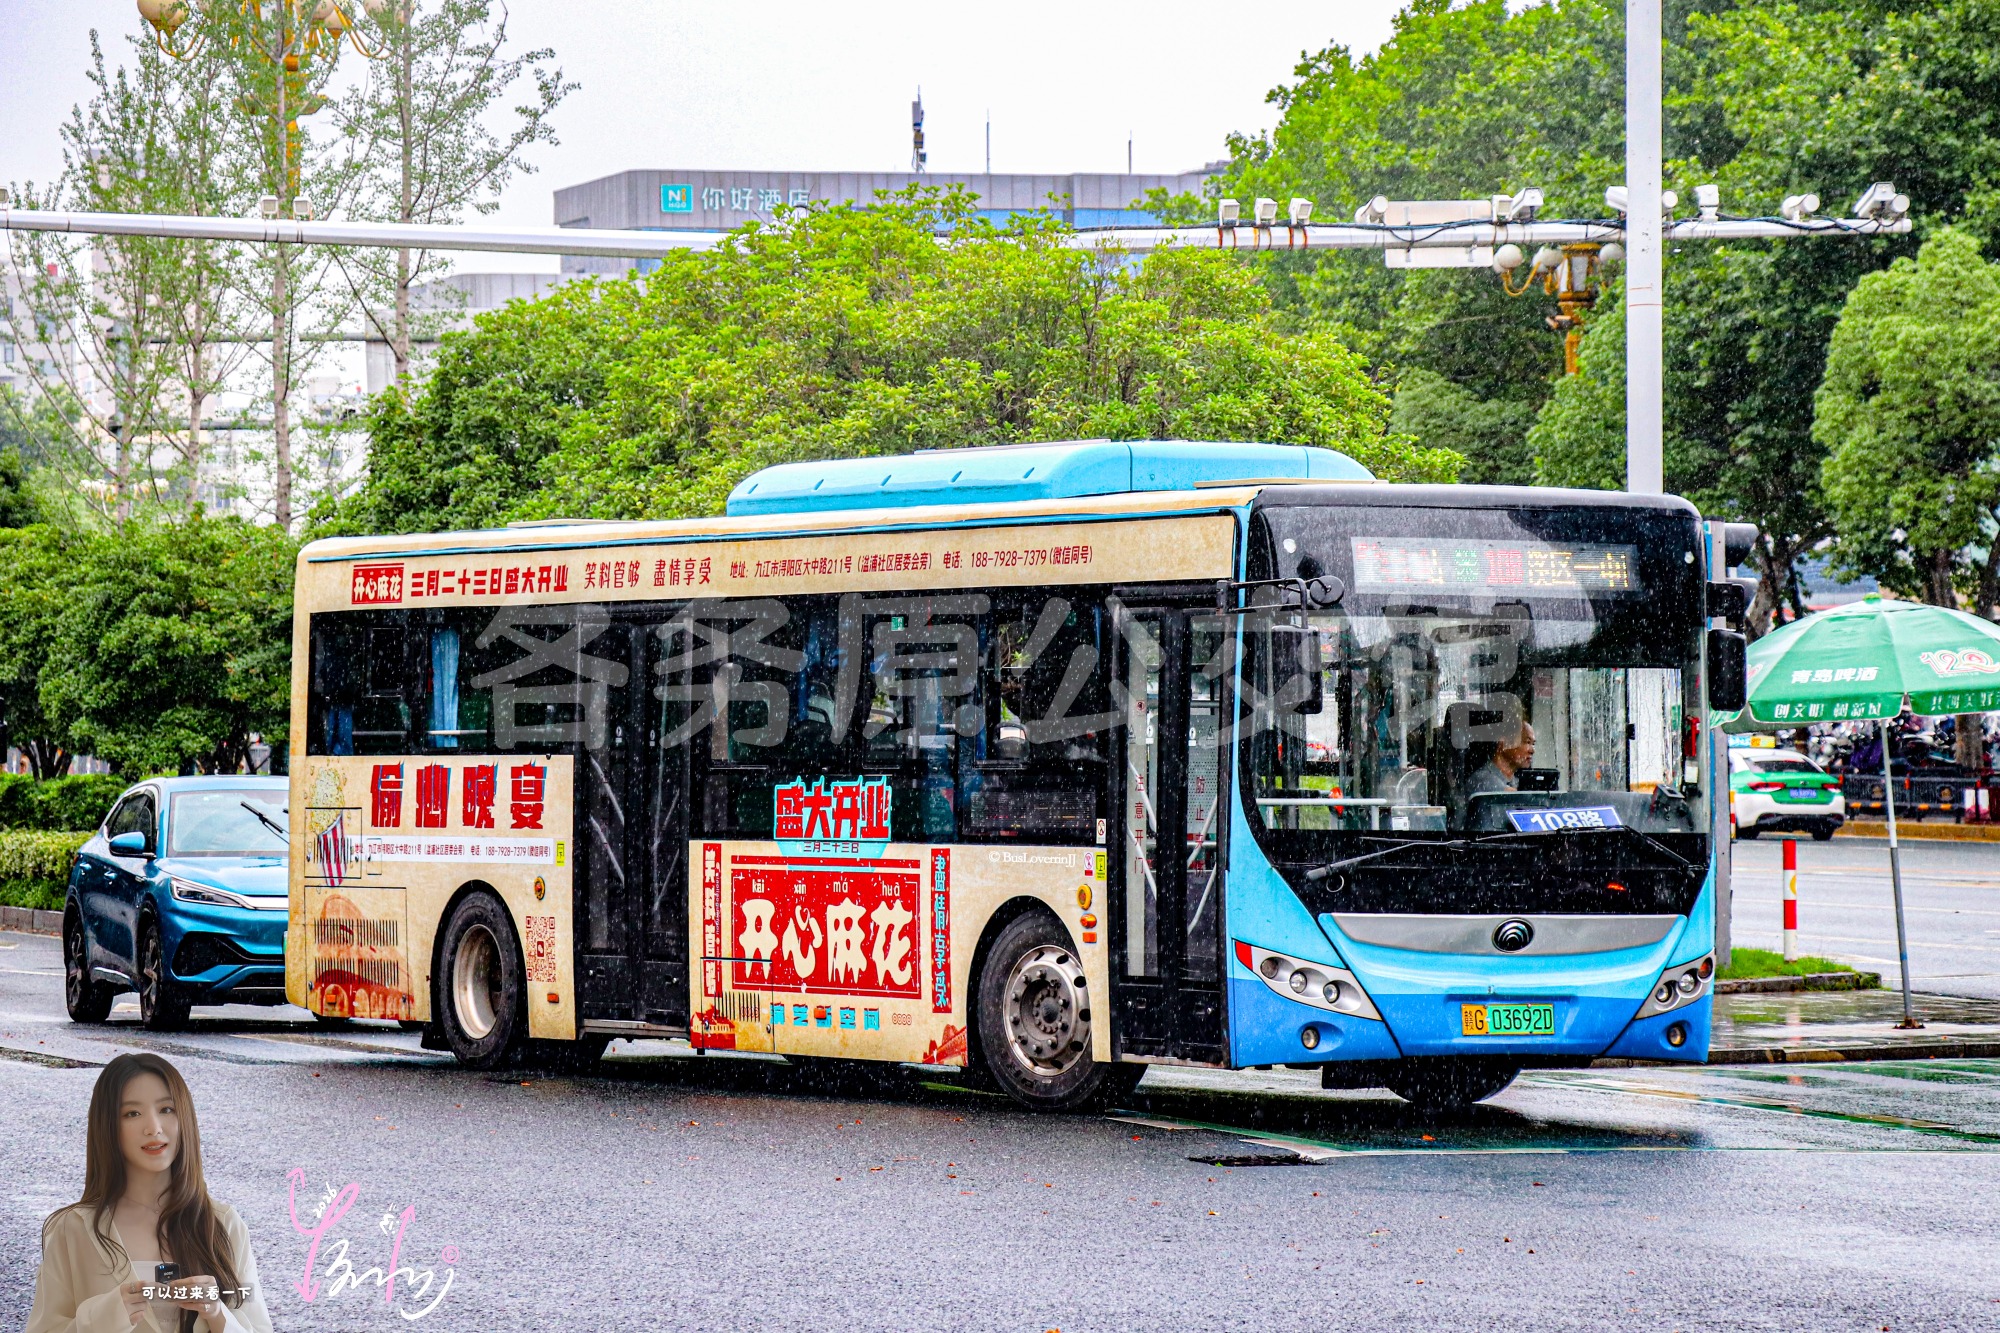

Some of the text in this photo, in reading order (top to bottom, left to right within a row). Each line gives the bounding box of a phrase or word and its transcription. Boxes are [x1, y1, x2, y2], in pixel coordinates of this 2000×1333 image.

[701, 187, 810, 211] 你好酒店
[353, 574, 402, 602] 开心麻花
[411, 565, 568, 598] 三月二十三日盛大开业
[584, 560, 641, 589] 笑料管够
[775, 777, 891, 840] 盛大开业
[1133, 773, 1145, 874] 注意开门
[1530, 810, 1604, 831] 108路
[803, 841, 859, 853] 三月二十三日
[738, 897, 913, 987] 开心麻花
